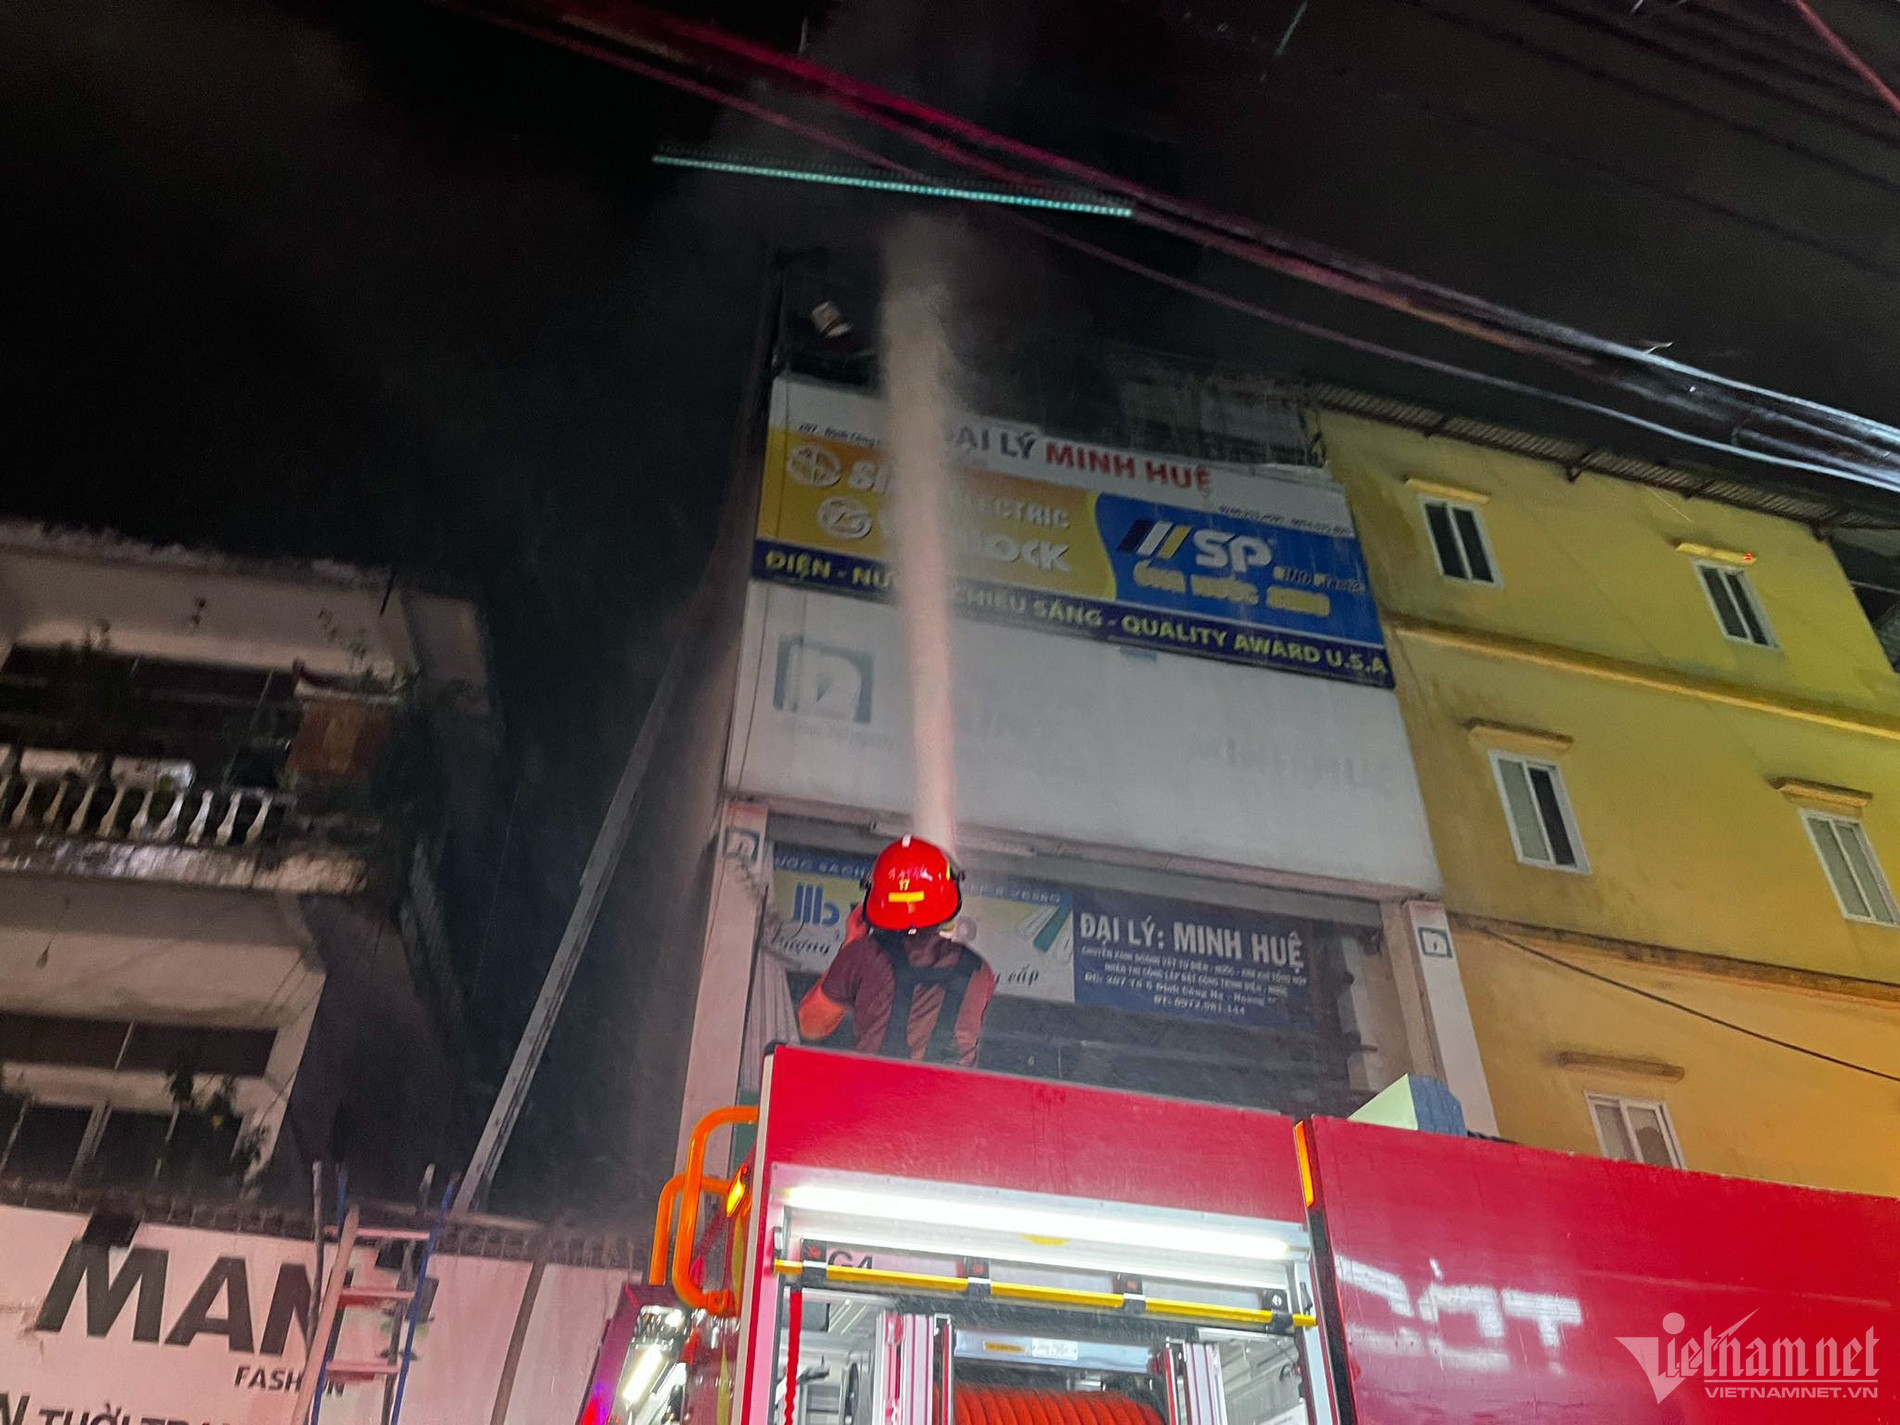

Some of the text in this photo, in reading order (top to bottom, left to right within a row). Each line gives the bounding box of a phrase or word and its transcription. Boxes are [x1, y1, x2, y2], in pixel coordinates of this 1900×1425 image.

[1001, 430, 1037, 460] LÝ
[1046, 440, 1137, 479] MINH
[1145, 460, 1212, 498] HUỆ
[765, 550, 831, 579] ĐIỆN
[1032, 598, 1103, 627] SÁNG
[1121, 614, 1228, 648] QUALITY
[1234, 633, 1321, 663] AWARD
[1080, 911, 1119, 945] ĐẠI
[1172, 921, 1243, 960] MINH
[1251, 930, 1305, 974] HUỆ
